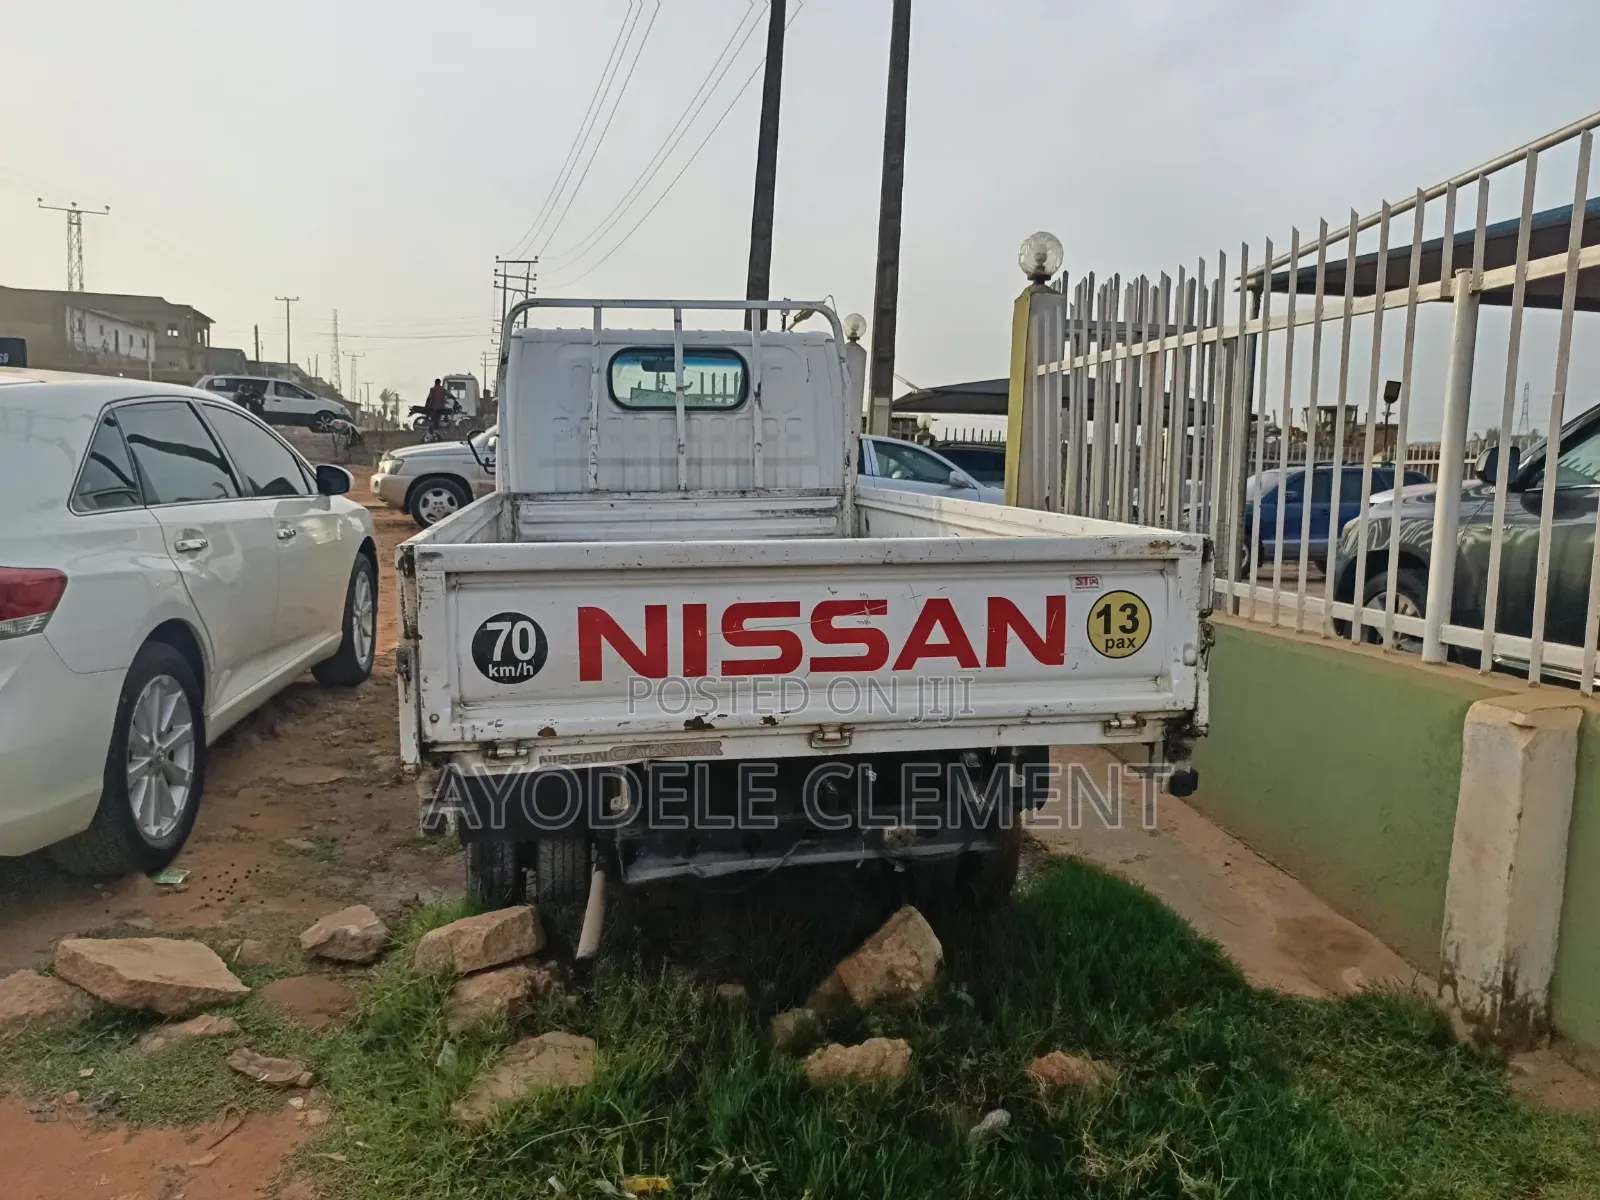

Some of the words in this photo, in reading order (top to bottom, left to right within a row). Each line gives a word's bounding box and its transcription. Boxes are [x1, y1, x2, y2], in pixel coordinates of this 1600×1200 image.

[1096, 603, 1139, 634] 13
[486, 620, 537, 662] 70
[578, 595, 1066, 681] NISSAN
[1104, 637, 1136, 653] pax
[488, 662, 534, 678] km/h
[538, 752, 609, 766] NISSAN
